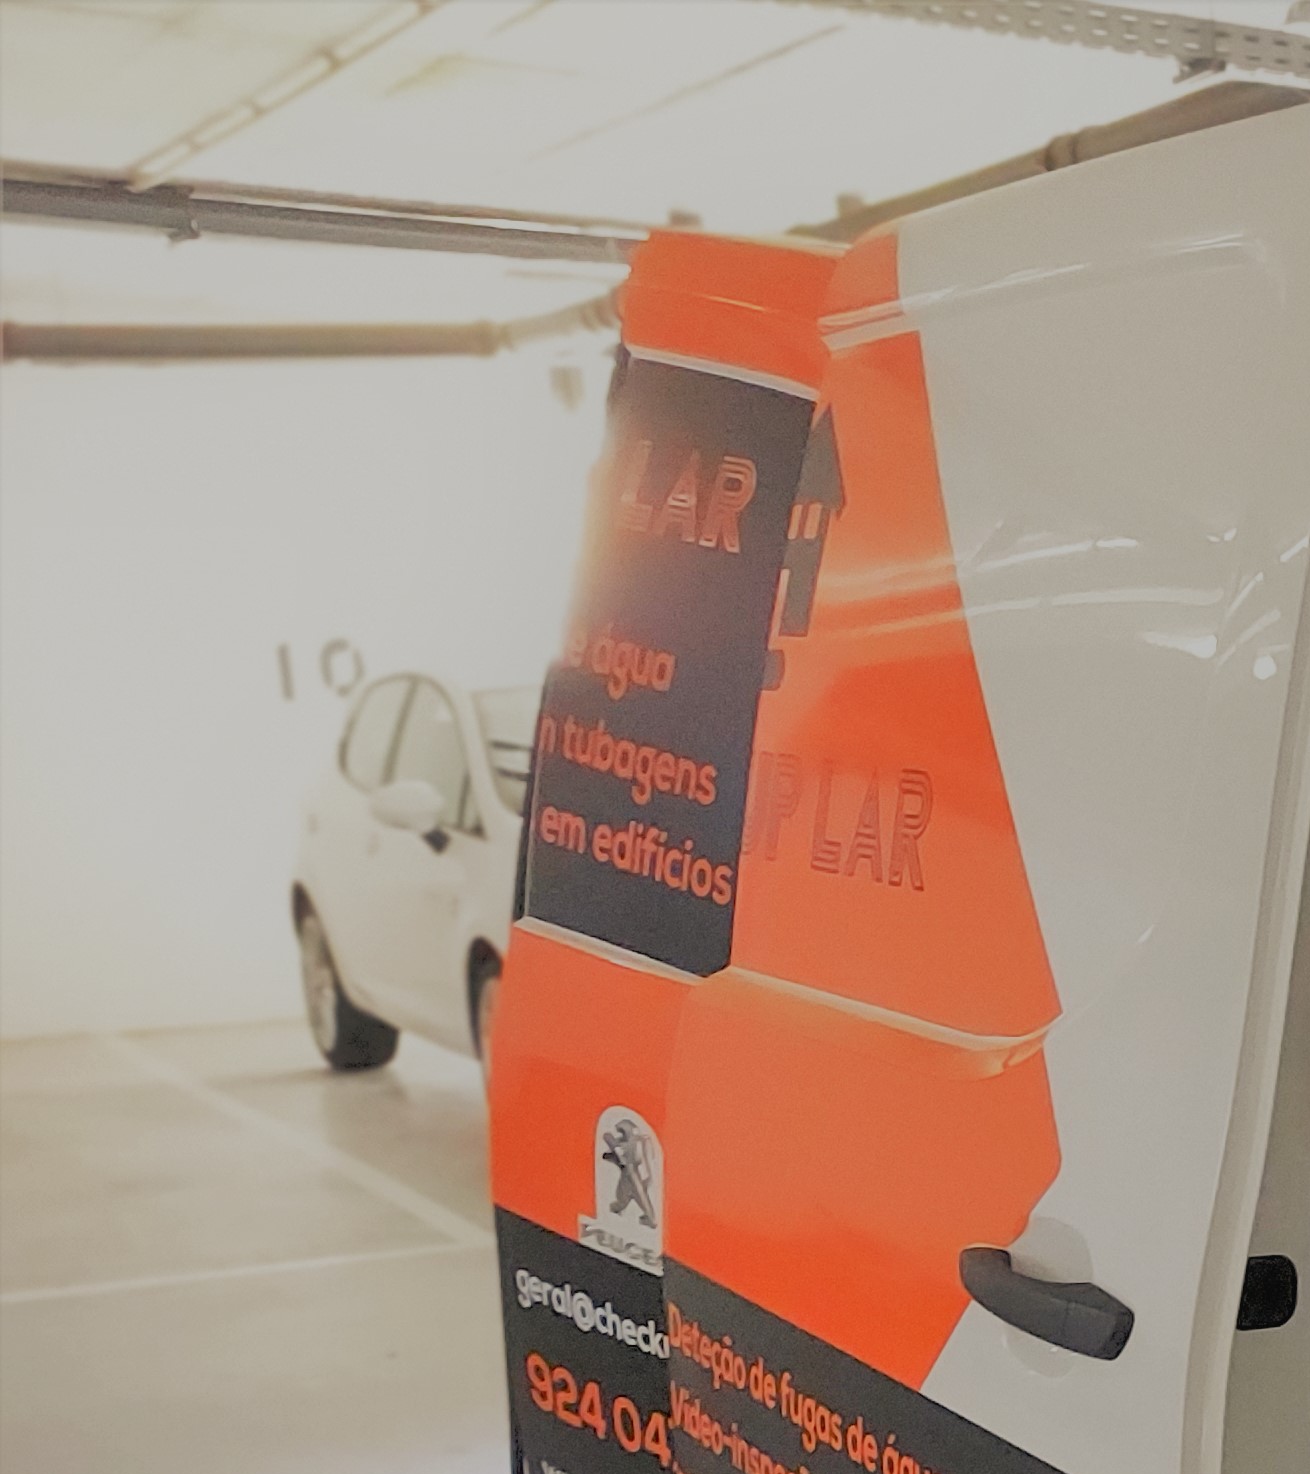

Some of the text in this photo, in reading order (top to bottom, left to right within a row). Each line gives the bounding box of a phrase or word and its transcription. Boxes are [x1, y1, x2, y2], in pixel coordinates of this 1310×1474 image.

[610, 438, 758, 554] LAR
[563, 714, 718, 806] tubagens
[539, 806, 735, 906] em edifícios
[809, 758, 934, 892] LAR
[526, 1352, 674, 1467] 924 04
[668, 1301, 746, 1390] Deteção
[750, 1355, 776, 1409] de
[779, 1371, 843, 1453] fugas
[846, 1416, 878, 1473] de
